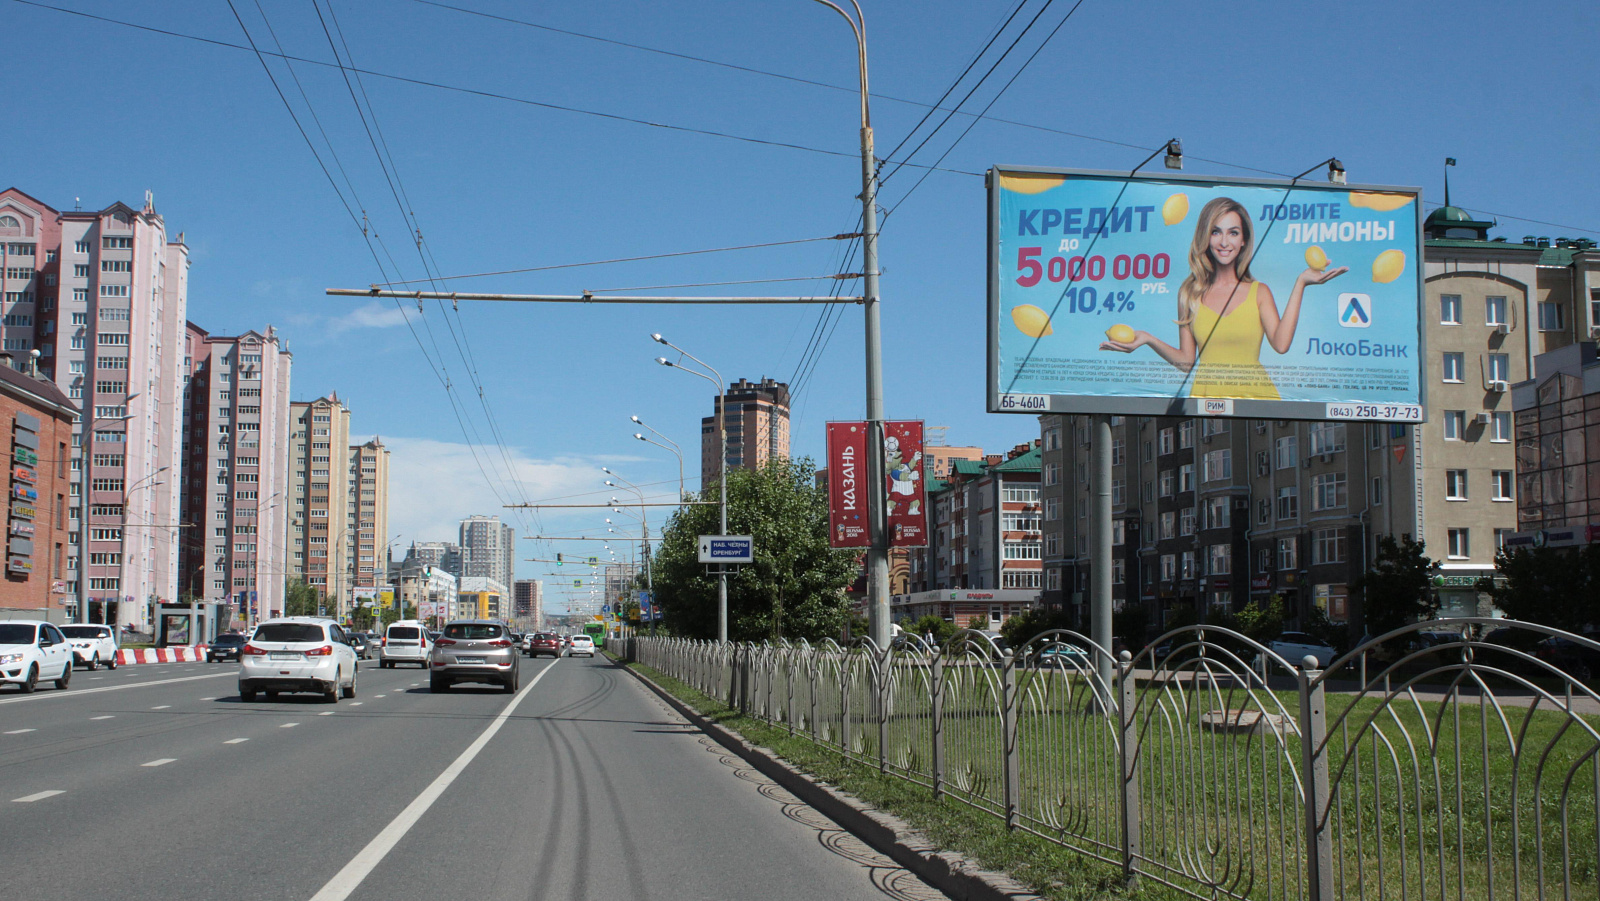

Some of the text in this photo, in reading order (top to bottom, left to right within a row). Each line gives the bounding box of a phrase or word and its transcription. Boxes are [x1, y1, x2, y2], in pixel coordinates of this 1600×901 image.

[1018, 205, 1155, 239] КРЕДИТ
[1260, 202, 1341, 222] ЛОВИТЕ
[1283, 220, 1395, 244] ЛИМОНЫ
[1058, 238, 1080, 253] ДО
[1016, 246, 1171, 288] 5 000 000
[1141, 282, 1170, 295] РУБ.
[1065, 286, 1135, 315] 10,4%
[1305, 336, 1408, 358] ЛокоБанк
[1002, 395, 1046, 410] ББ-460А
[1206, 400, 1225, 411] РИМ
[1329, 404, 1420, 420] (843) 250-37-73
[842, 446, 856, 510] КАЗАНЬ
